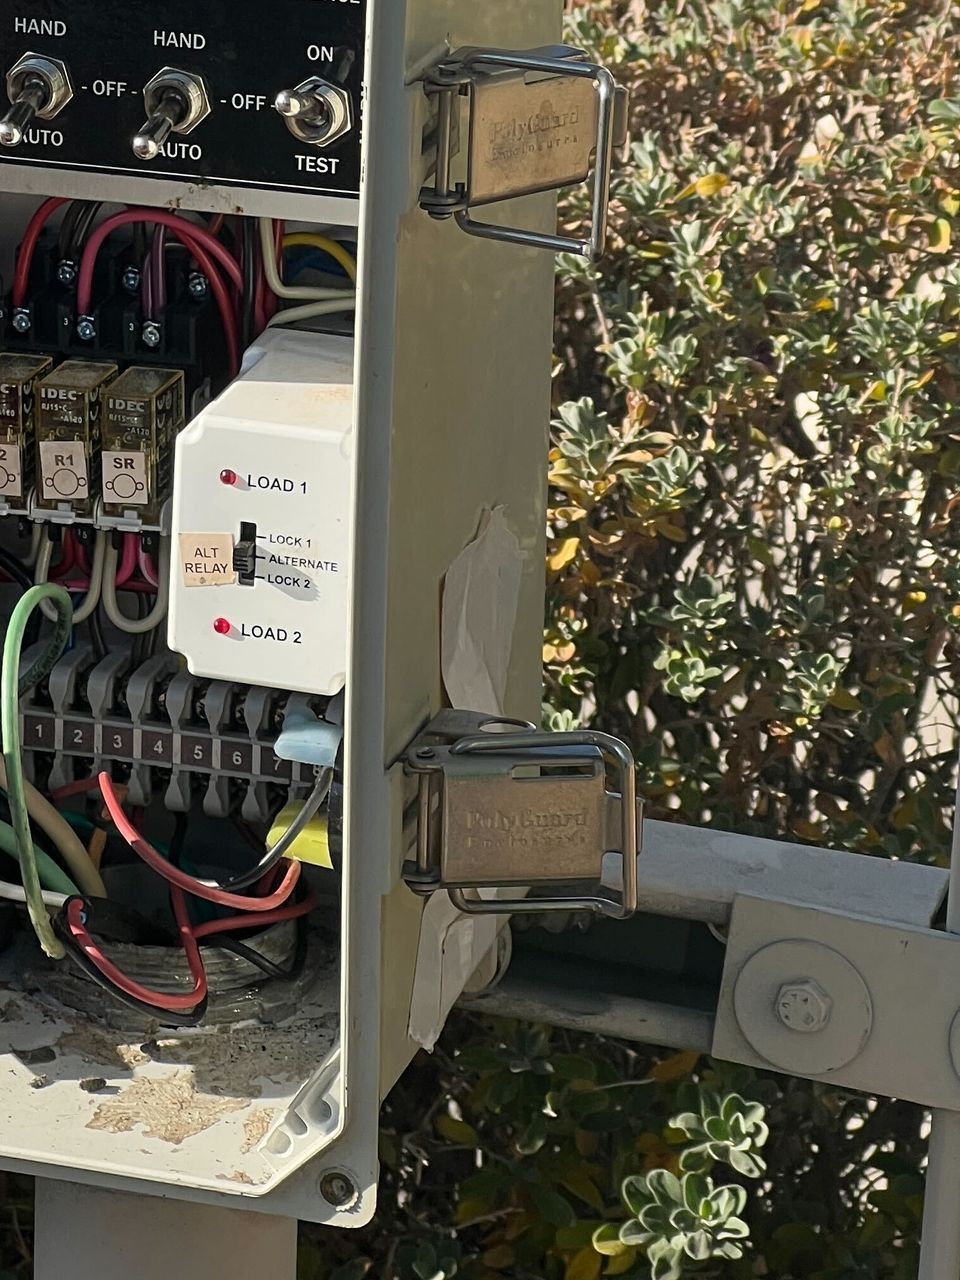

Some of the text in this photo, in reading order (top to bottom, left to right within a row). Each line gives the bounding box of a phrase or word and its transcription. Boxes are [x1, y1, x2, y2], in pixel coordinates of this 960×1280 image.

[14, 16, 67, 37] HAND
[153, 30, 207, 51] HAND
[306, 44, 335, 63] ON
[294, 154, 340, 175] TEST
[41, 387, 77, 401] IDEC
[108, 398, 145, 413] IDEC
[54, 453, 74, 467] R1
[112, 457, 136, 470] SR
[246, 474, 307, 494] LOAD 1
[269, 533, 312, 548] LOCK 1
[194, 547, 220, 558] ALT
[184, 562, 229, 576] RELAY
[268, 555, 339, 573] ALTERNATE
[267, 573, 311, 589] LOCK 2
[240, 623, 303, 644] LOAD 2
[35, 723, 43, 738] 1
[73, 729, 83, 744] 2
[112, 734, 122, 749] 3
[153, 739, 164, 754] 4
[193, 745, 203, 760] 5
[232, 751, 242, 765] 6
[272, 756, 282, 771] 7
